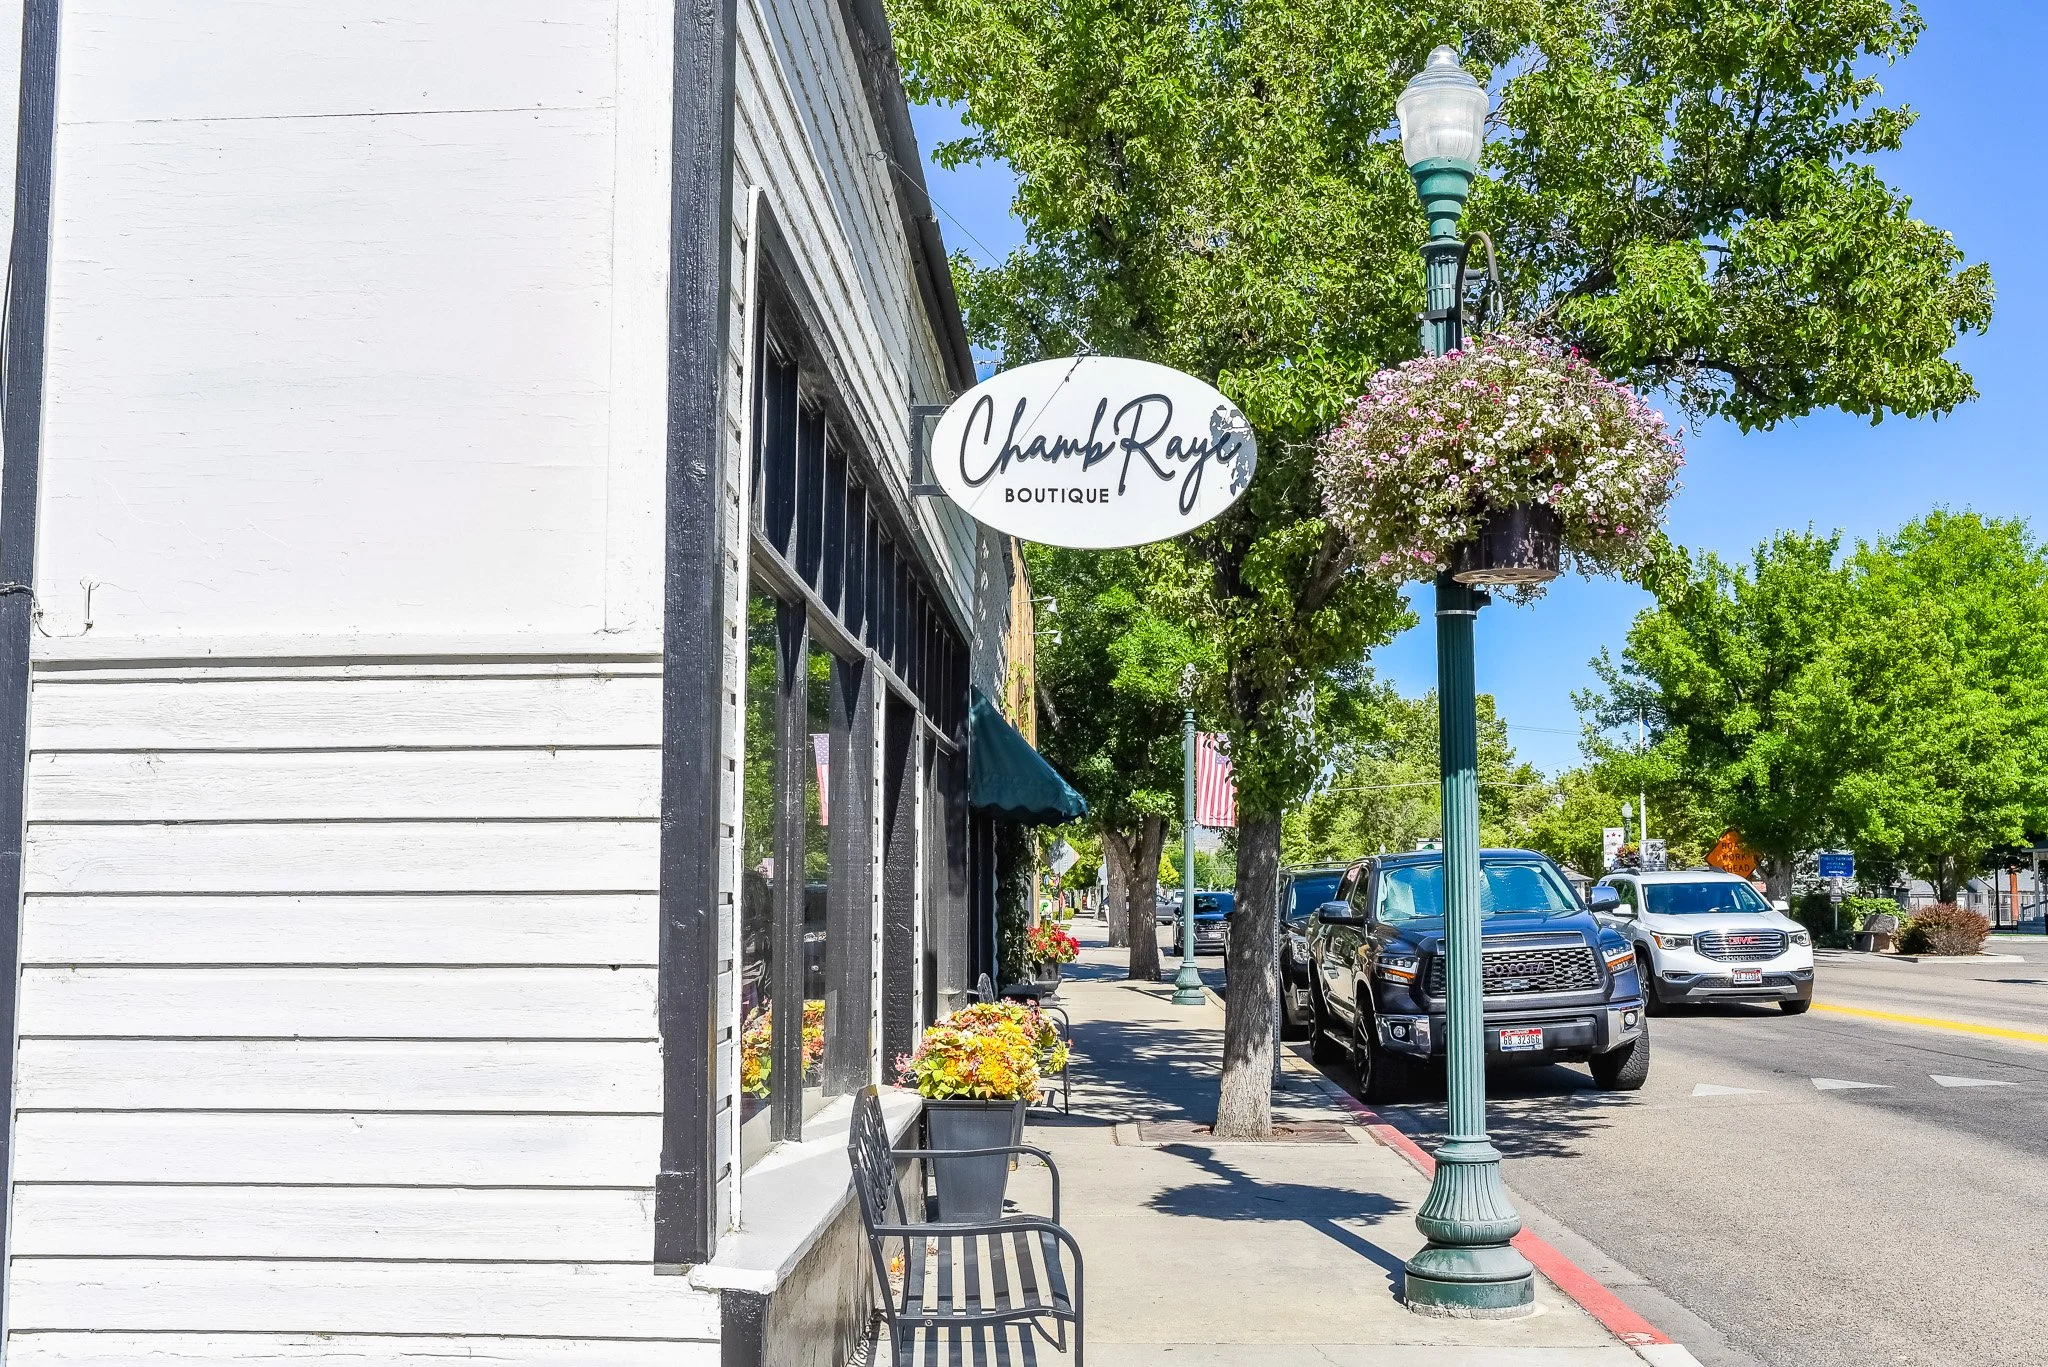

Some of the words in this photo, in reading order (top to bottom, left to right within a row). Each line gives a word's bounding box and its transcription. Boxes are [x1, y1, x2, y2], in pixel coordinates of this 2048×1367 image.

[1004, 487, 1110, 504] BOUTIQUE
[1721, 842, 1744, 850] ROA
[1721, 853, 1747, 861] WORK
[1722, 864, 1750, 873] AHEAD
[1728, 936, 1759, 945] GMC
[1484, 962, 1547, 977] TOYOTA
